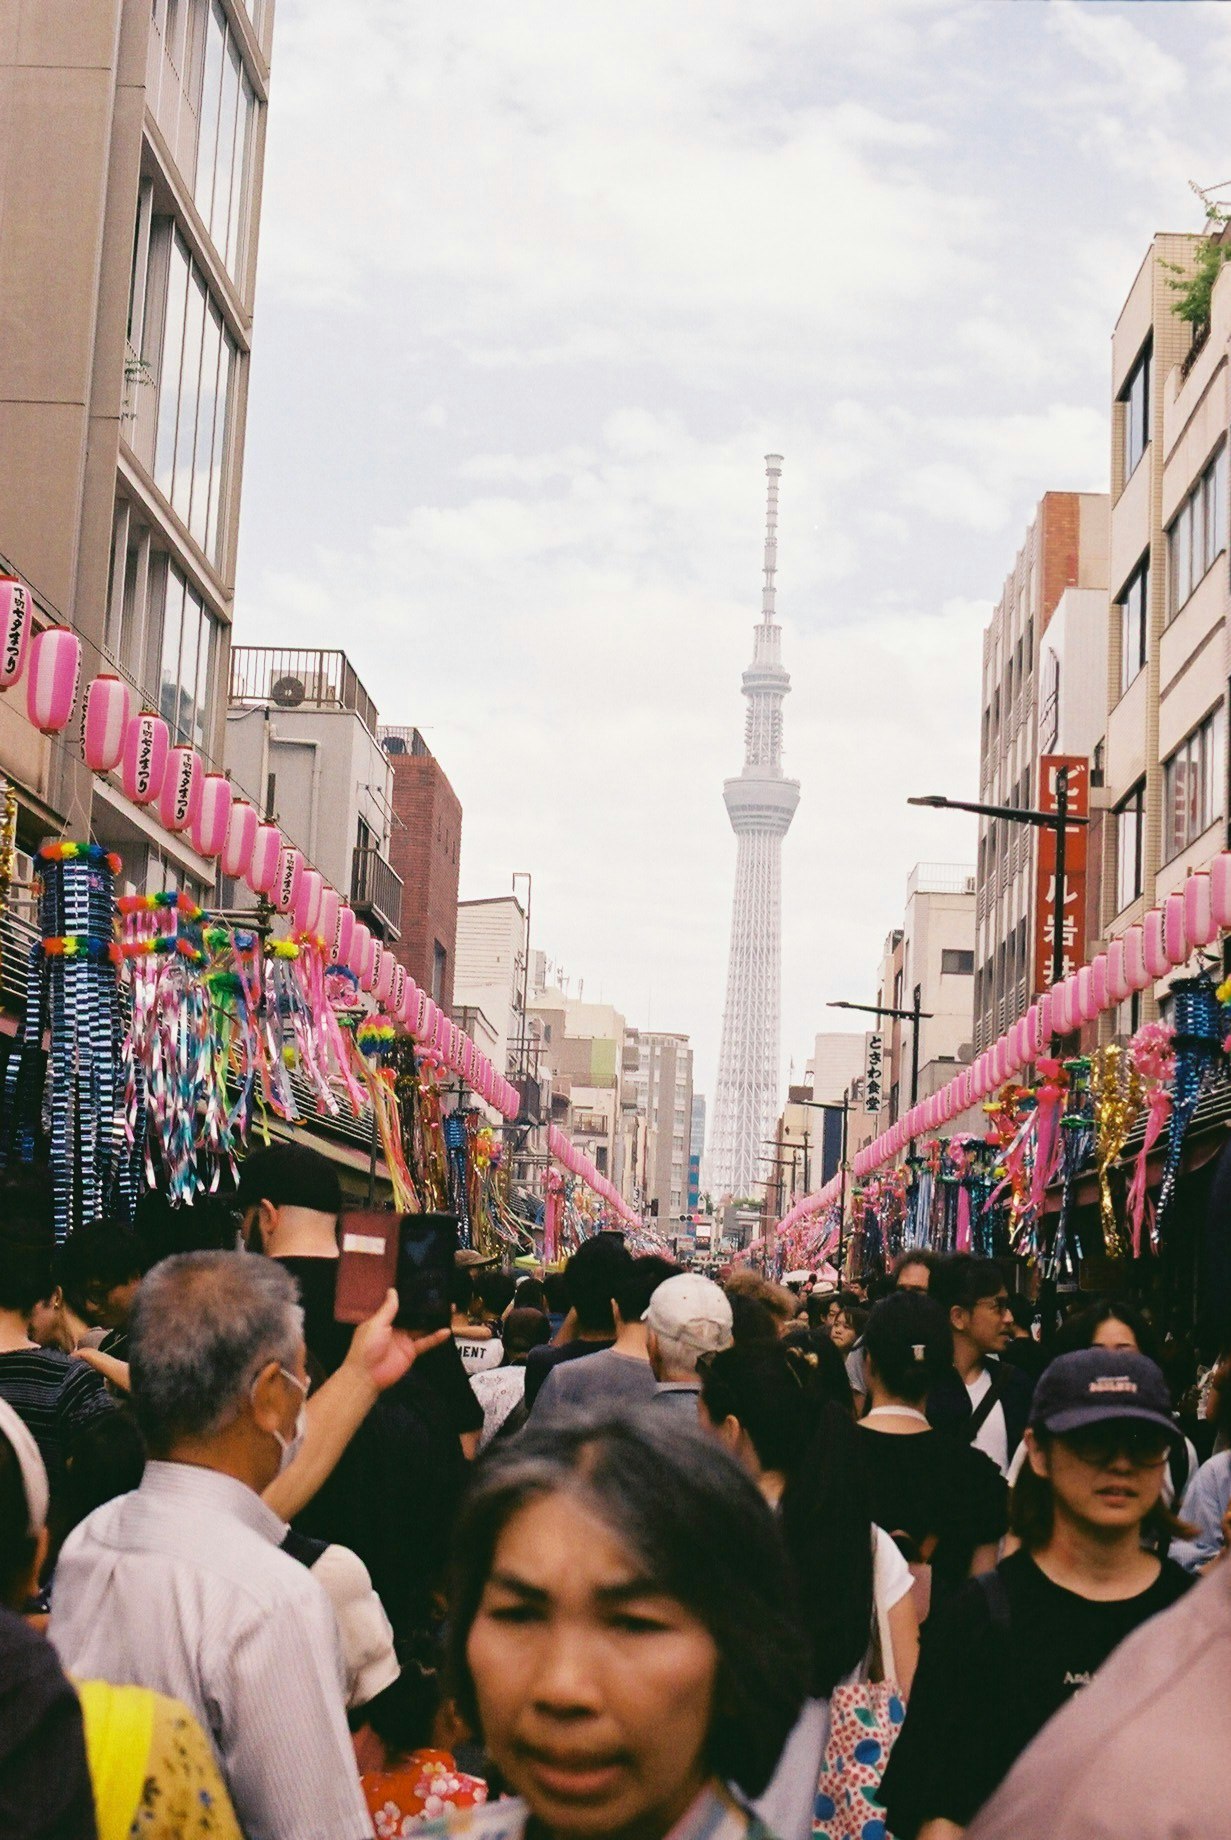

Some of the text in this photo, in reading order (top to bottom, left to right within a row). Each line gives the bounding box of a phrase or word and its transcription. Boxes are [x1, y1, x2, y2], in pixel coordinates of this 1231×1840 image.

[865, 1035, 882, 1112] ときわ食堂
